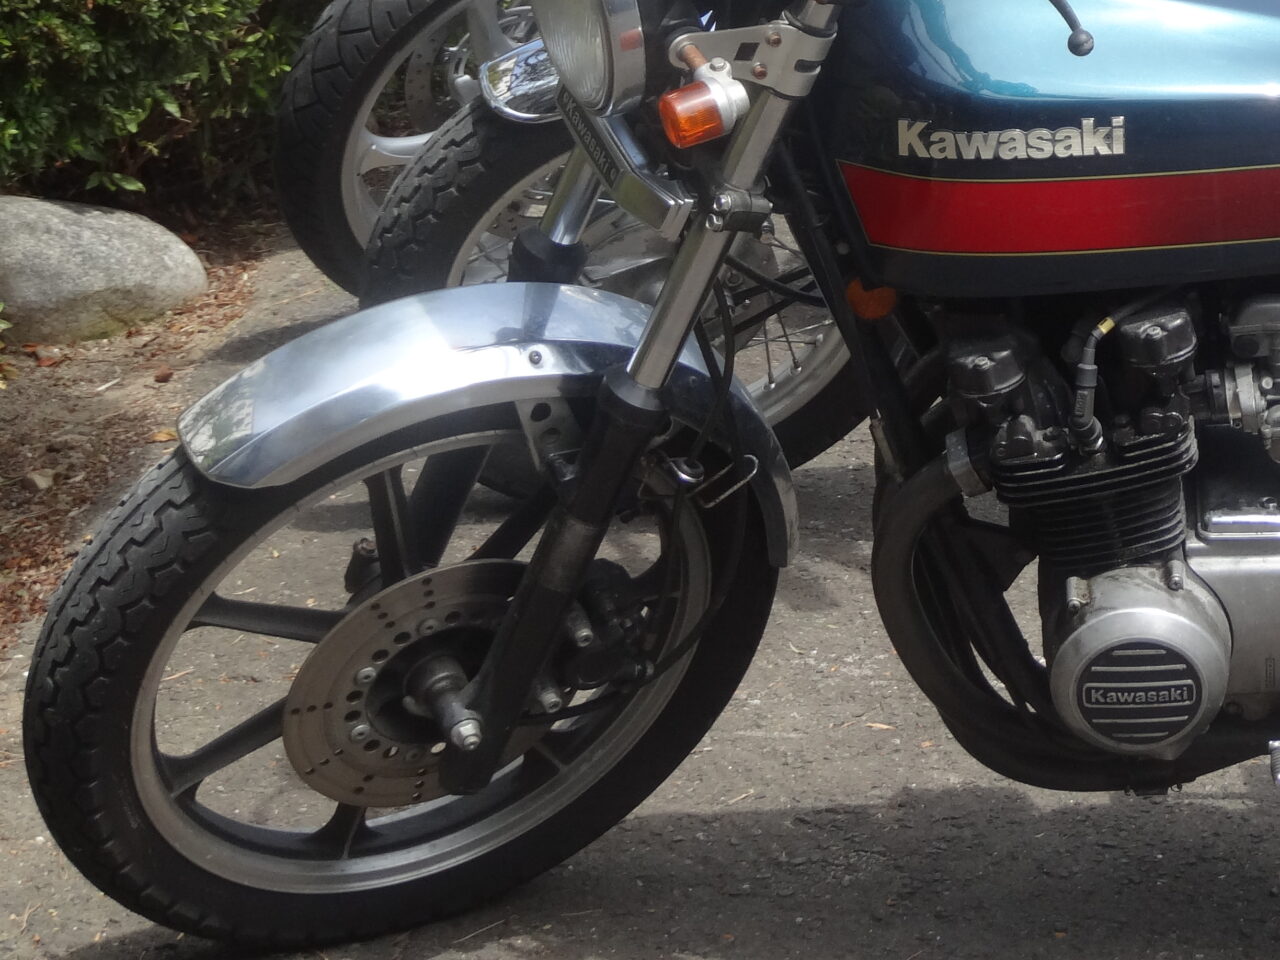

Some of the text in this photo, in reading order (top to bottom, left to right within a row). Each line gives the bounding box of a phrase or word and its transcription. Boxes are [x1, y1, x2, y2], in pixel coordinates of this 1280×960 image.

[566, 99, 611, 174] Kawasaki
[897, 115, 1126, 161] Kawasaki
[1091, 687, 1189, 704] Kawasaki
